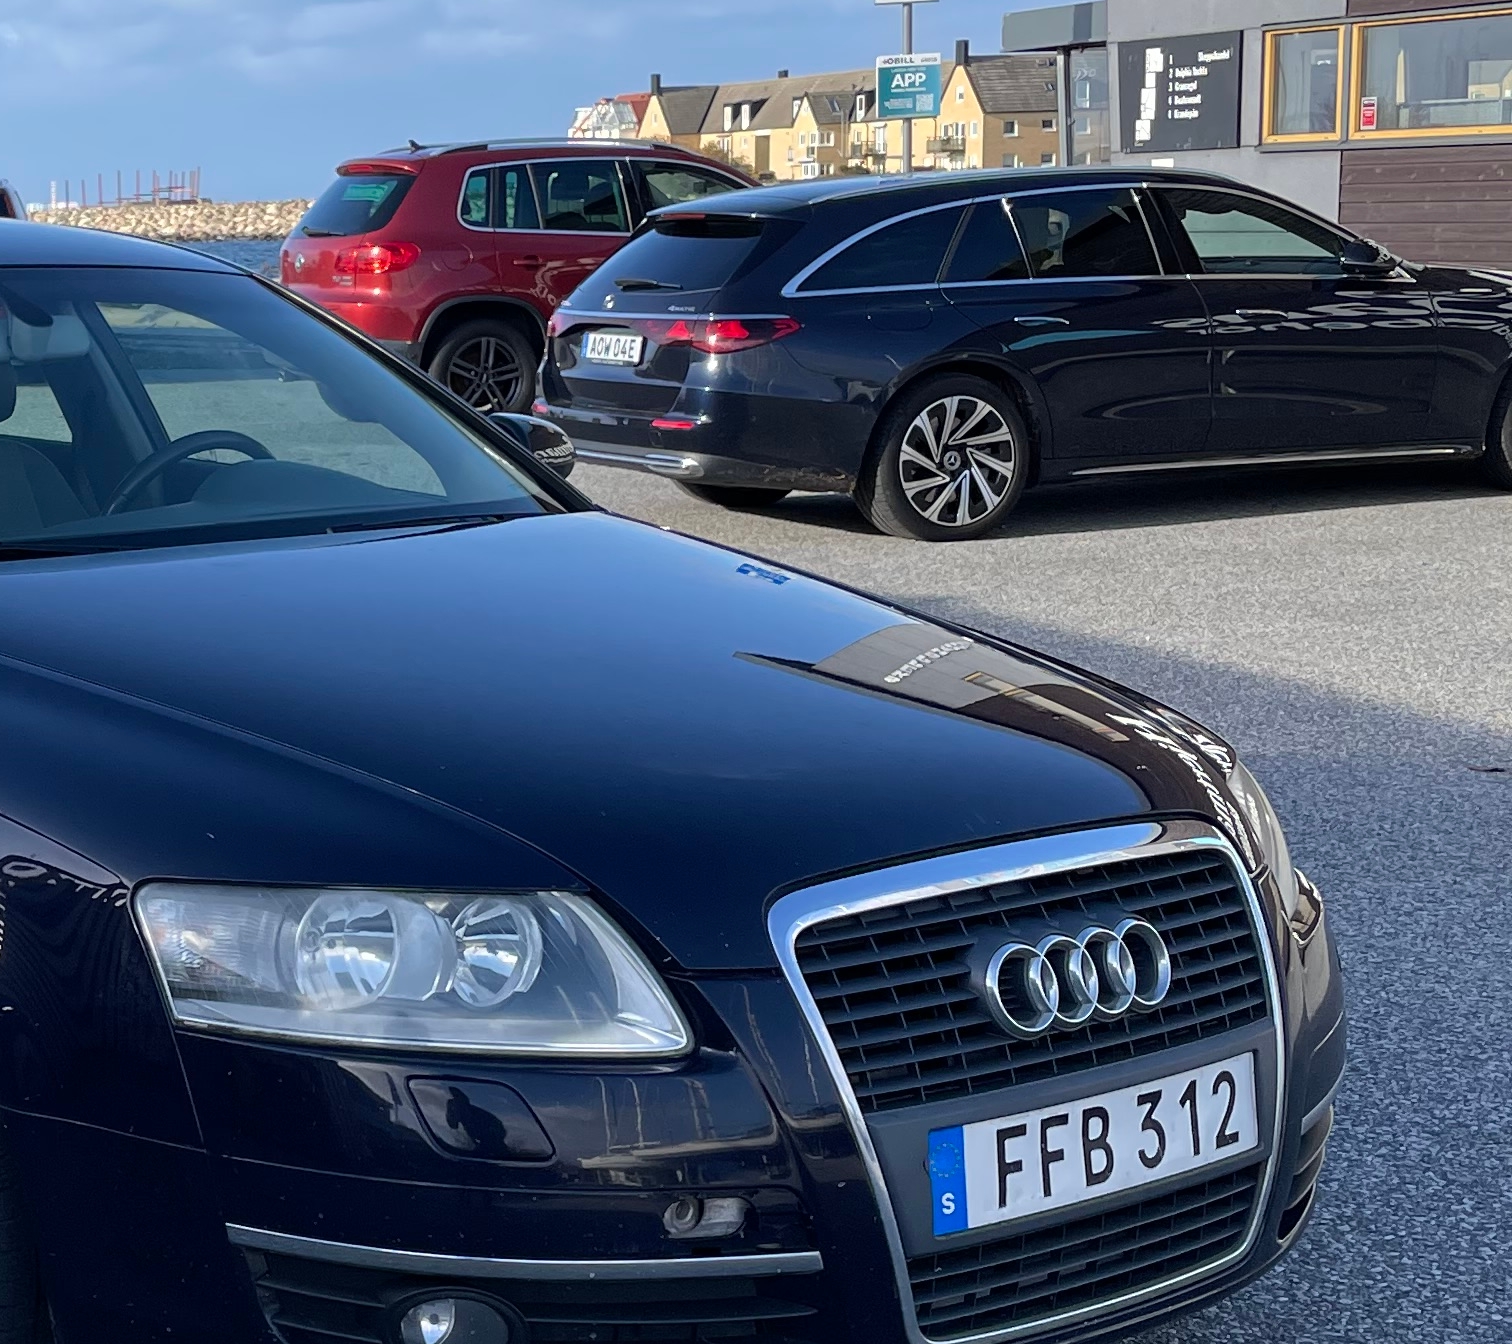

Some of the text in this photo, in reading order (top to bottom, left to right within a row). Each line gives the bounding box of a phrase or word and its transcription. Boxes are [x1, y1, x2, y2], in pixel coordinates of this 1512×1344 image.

[891, 72, 926, 87] APP
[996, 1070, 1240, 1209] FFB 312
[941, 1192, 956, 1215] S
